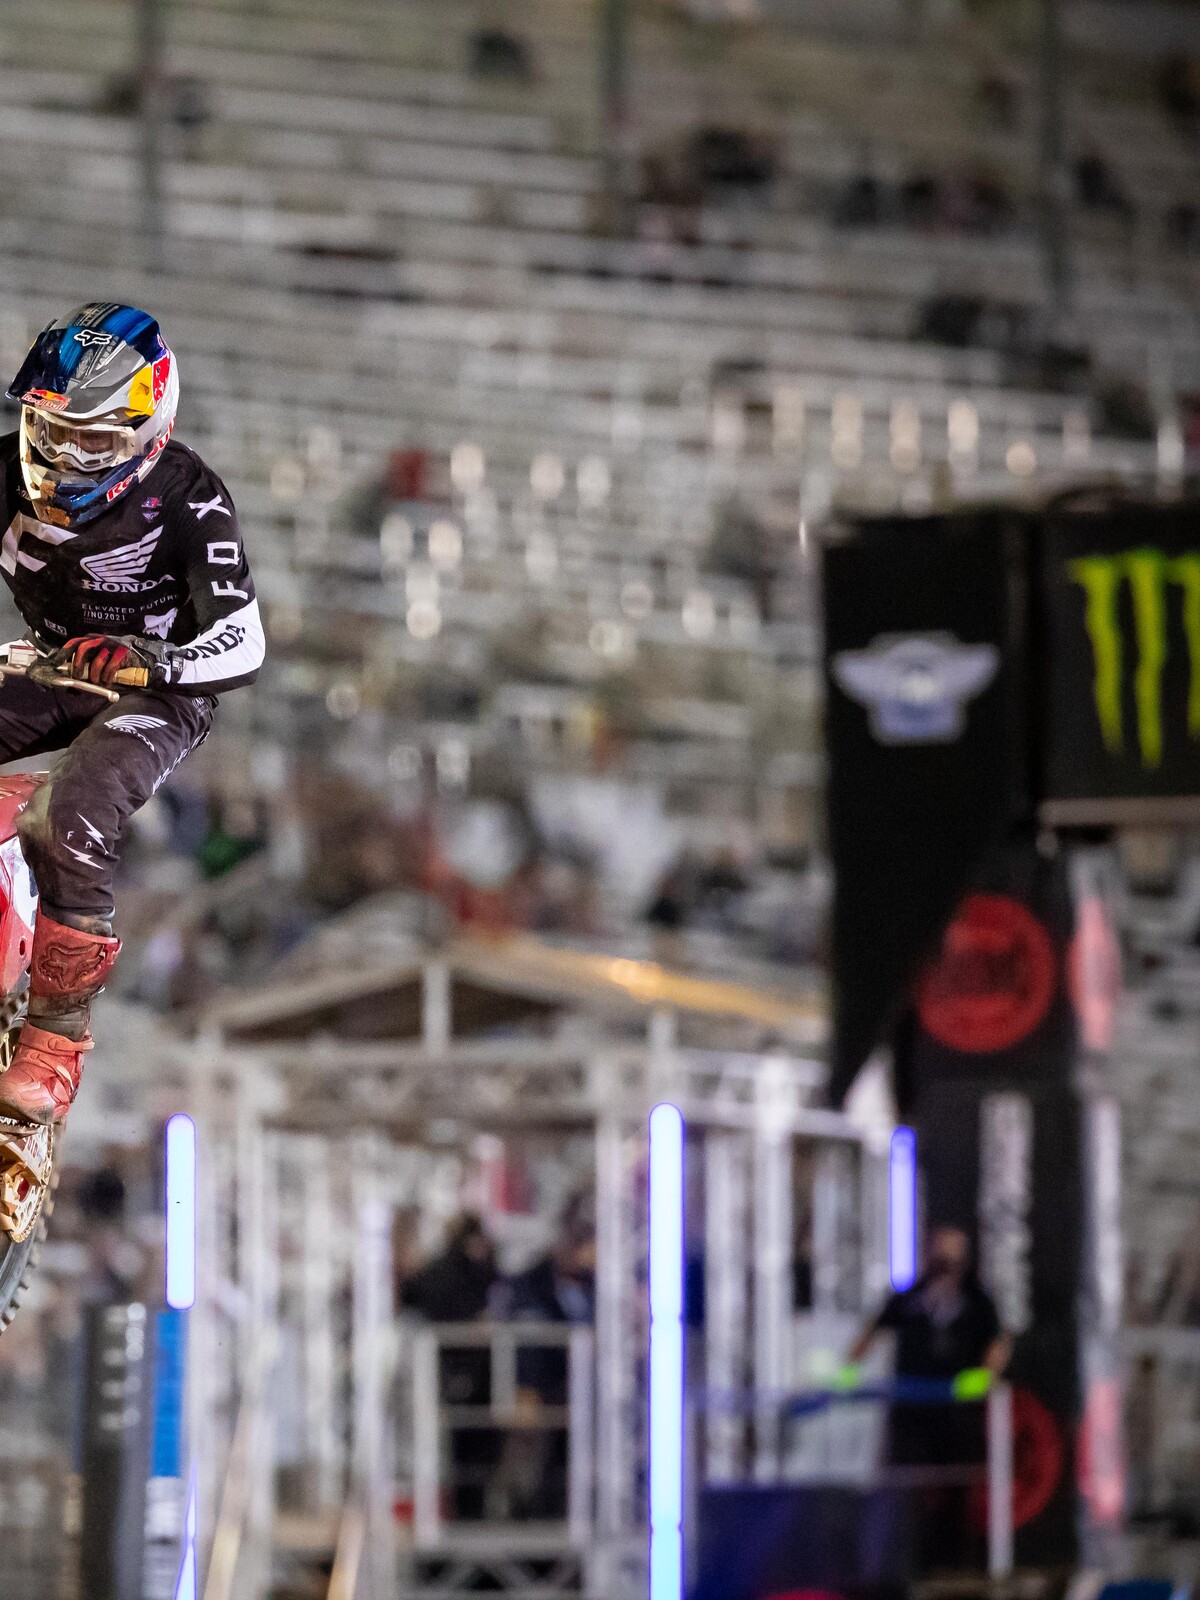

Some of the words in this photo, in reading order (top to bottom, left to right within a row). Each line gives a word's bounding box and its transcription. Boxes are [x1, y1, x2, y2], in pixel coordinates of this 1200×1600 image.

[188, 495, 248, 600] FOX
[82, 603, 135, 614] ELEVATED
[140, 594, 178, 611] FUTUR
[183, 624, 245, 661] ONDA
